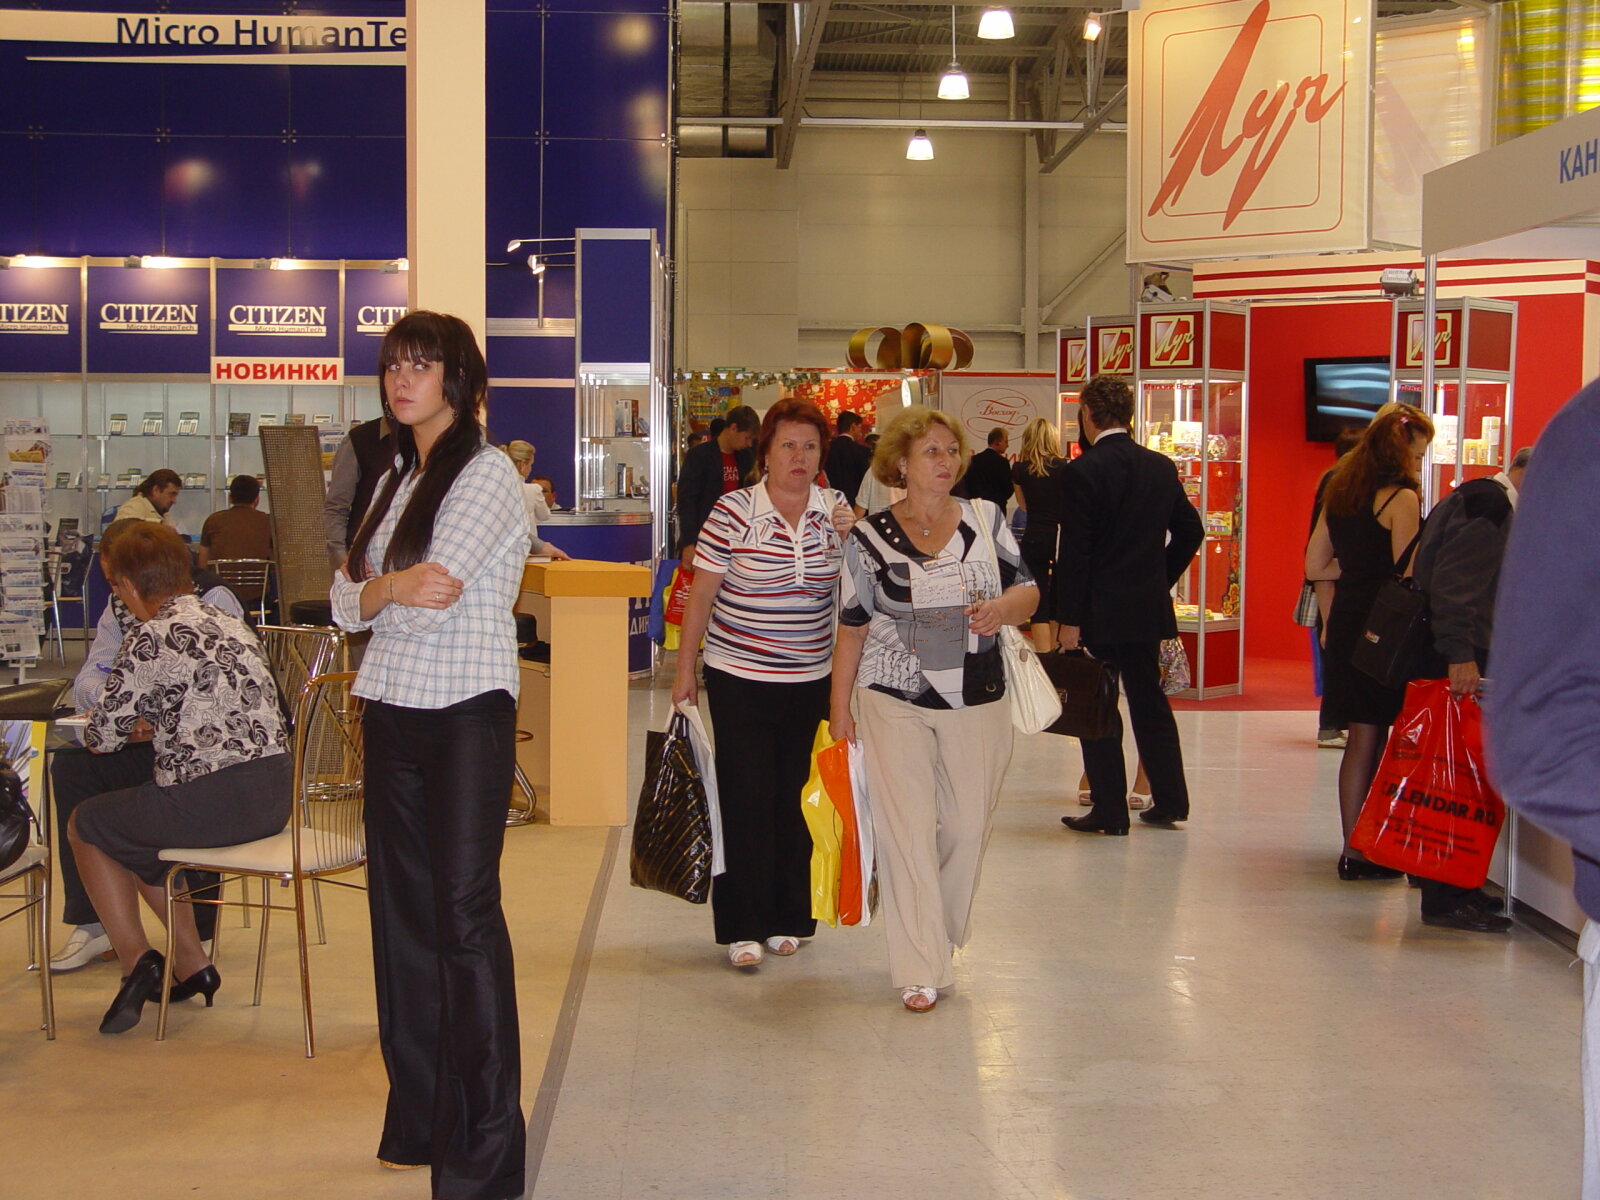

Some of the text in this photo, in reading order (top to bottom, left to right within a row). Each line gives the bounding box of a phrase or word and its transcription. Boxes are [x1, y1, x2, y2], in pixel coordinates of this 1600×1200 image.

[116, 17, 219, 45] Micro
[100, 303, 198, 323] CITIZEN
[229, 305, 327, 325] CITIZEN
[216, 363, 338, 381] НОВИНКИ
